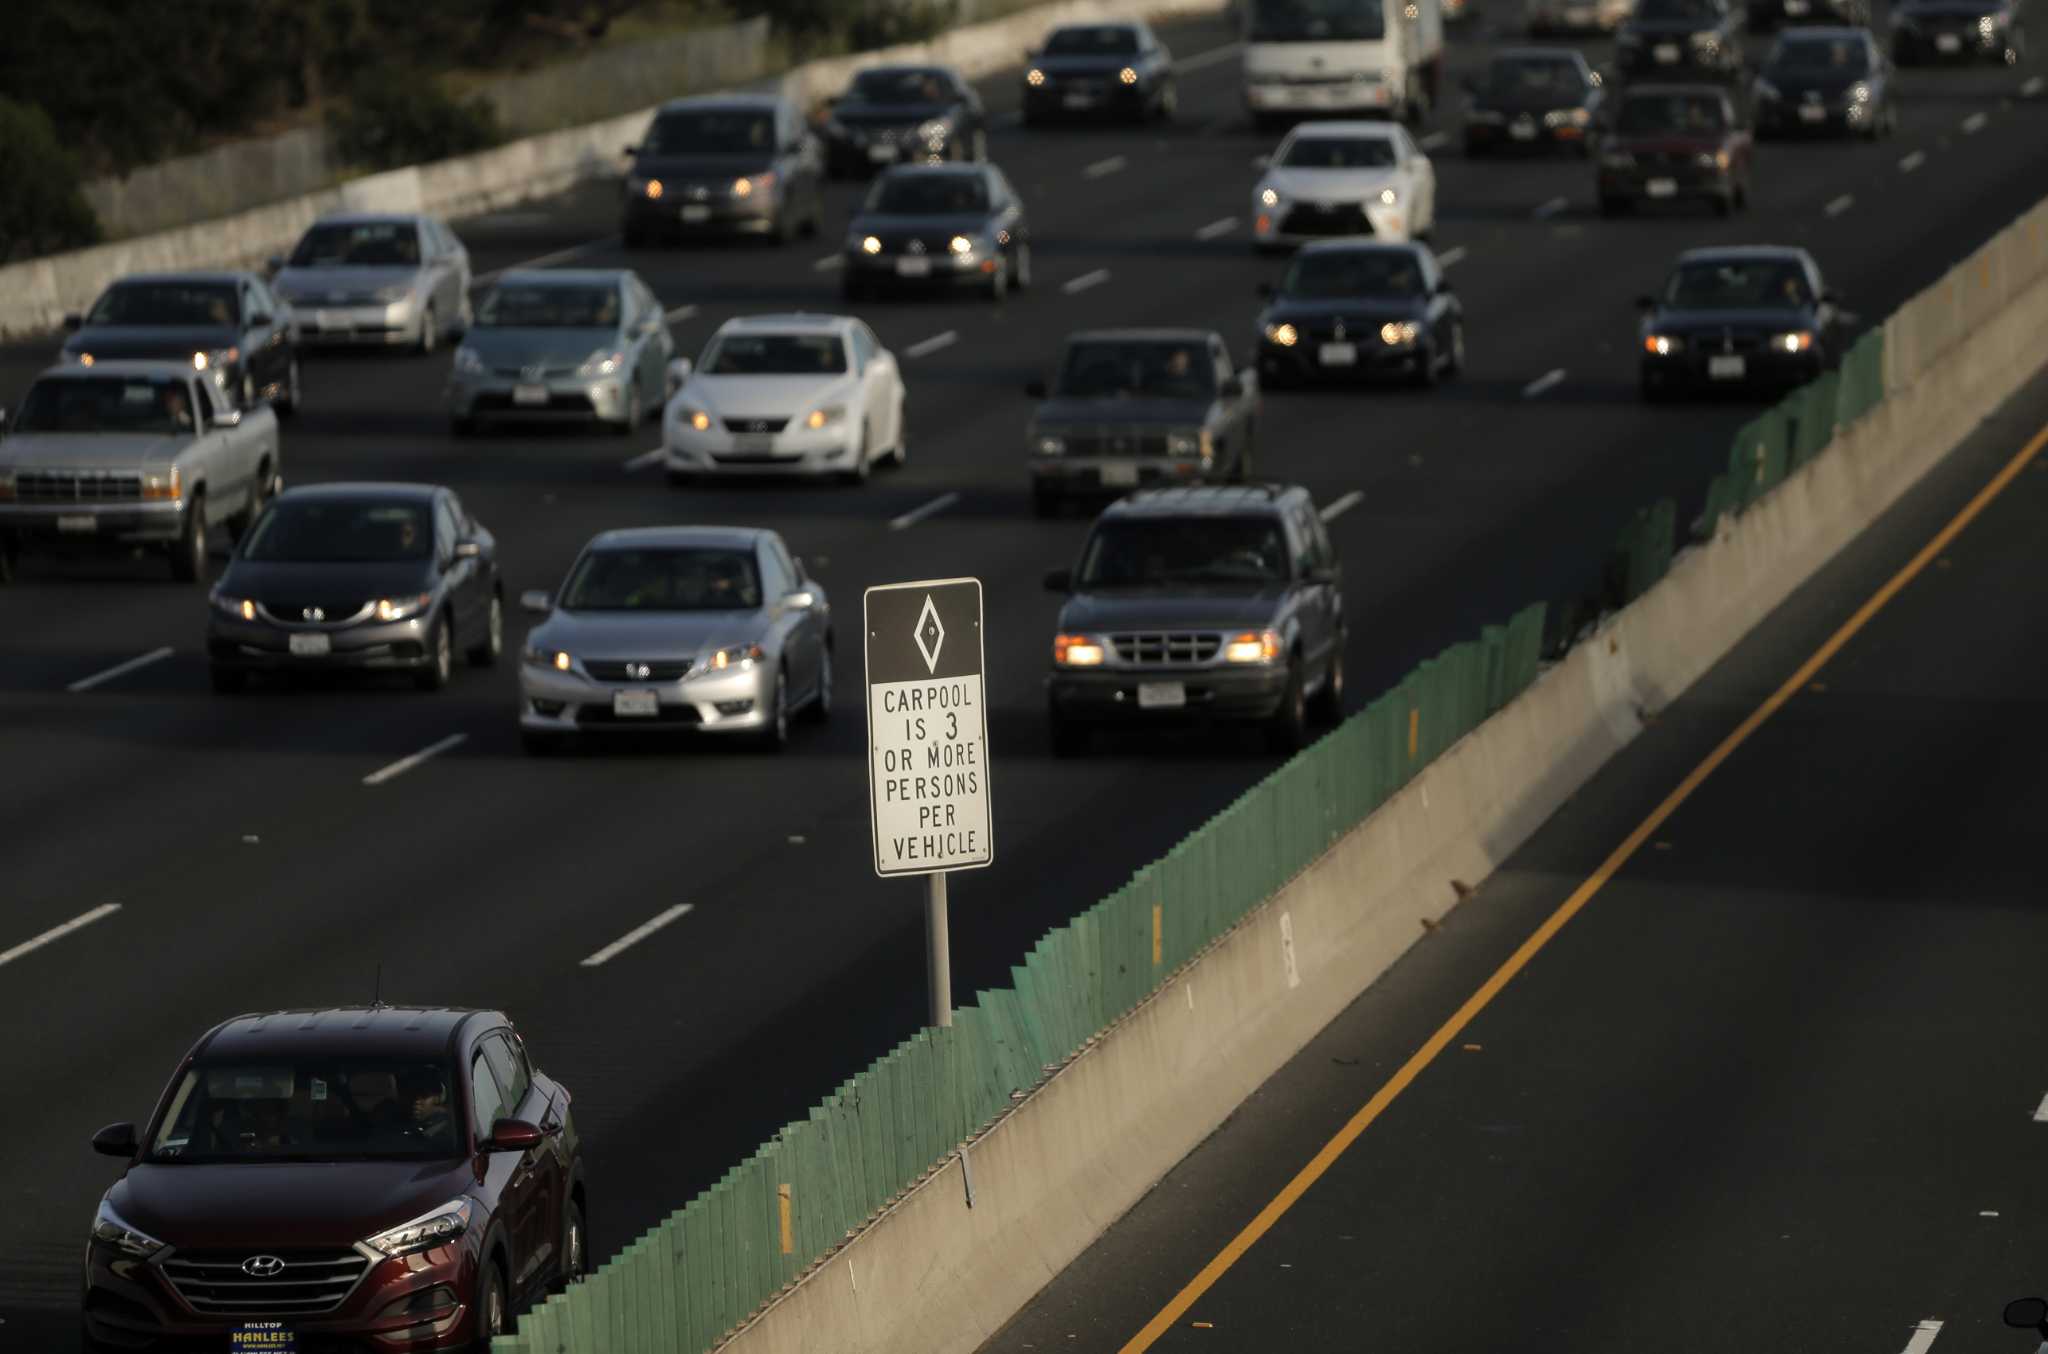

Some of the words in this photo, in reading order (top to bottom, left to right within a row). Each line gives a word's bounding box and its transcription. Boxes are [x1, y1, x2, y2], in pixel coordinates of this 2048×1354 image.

[884, 683, 972, 713] CARPOOL
[906, 718, 926, 741] IS
[945, 711, 958, 740] 3
[884, 748, 912, 772] OR
[927, 742, 976, 769] MORE
[886, 771, 978, 802] PERSONS
[919, 803, 955, 829] PER
[893, 830, 976, 860] VEHICLE
[233, 1332, 294, 1342] HANLEES
